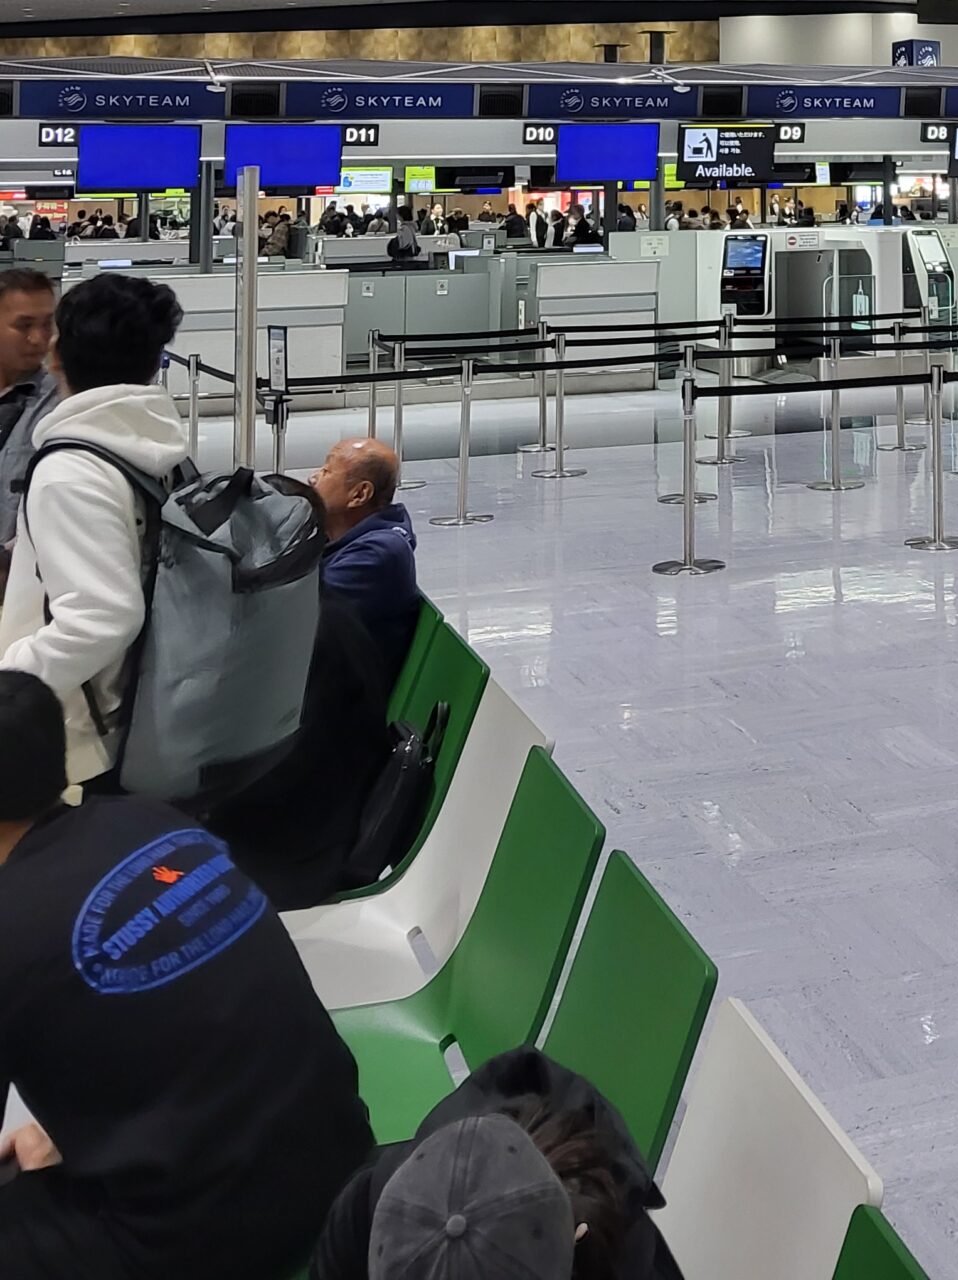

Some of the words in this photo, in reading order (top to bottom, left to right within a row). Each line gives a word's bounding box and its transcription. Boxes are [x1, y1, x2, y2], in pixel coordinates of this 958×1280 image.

[95, 95, 190, 106] SKYTEAM
[355, 96, 442, 107] SKYTEAM
[590, 97, 669, 108] SKYTEAM
[803, 97, 875, 109] SKYTEAM
[41, 127, 75, 143] D12
[346, 128, 375, 143] D11
[525, 128, 554, 141] D10
[780, 126, 802, 140] D9
[927, 127, 948, 140] D8
[695, 164, 756, 178] Available.
[102, 907, 160, 960] STUSSY
